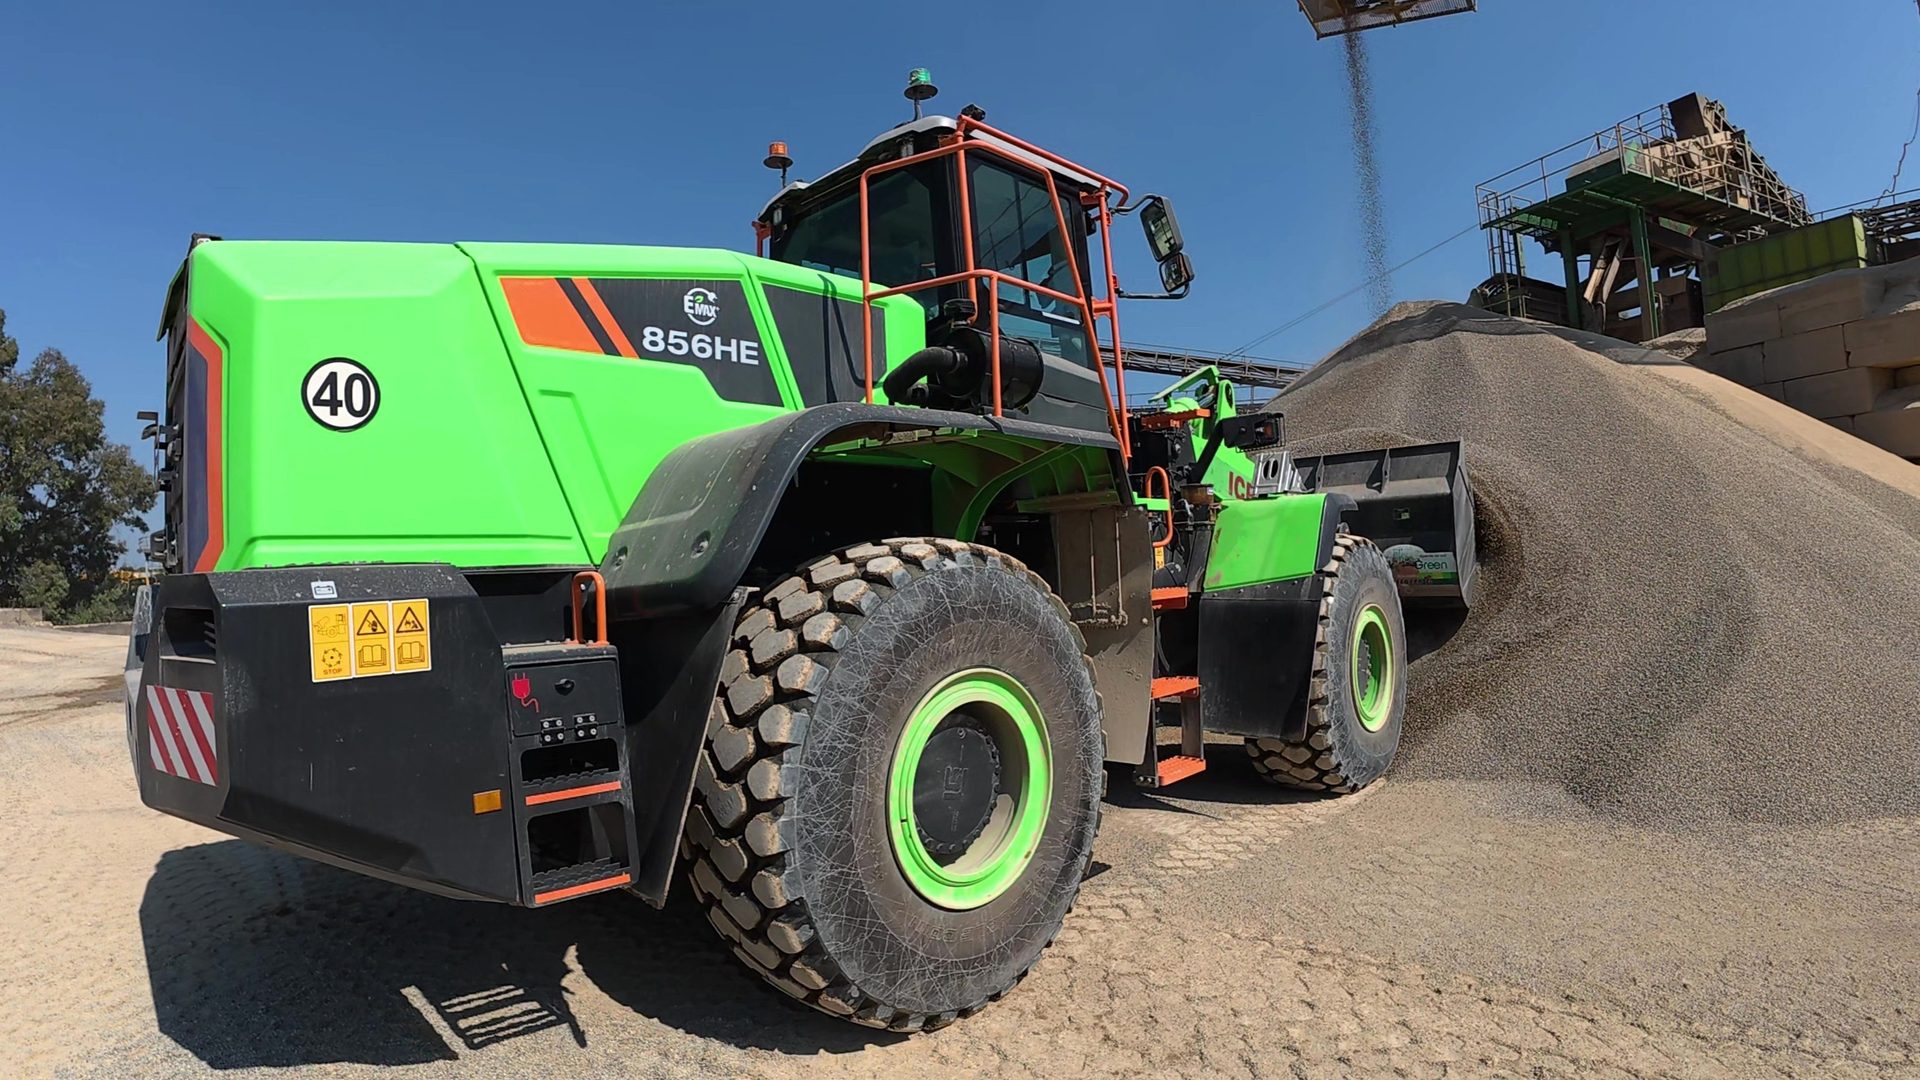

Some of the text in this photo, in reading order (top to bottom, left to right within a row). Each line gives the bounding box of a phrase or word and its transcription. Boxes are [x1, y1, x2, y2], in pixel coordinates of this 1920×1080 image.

[642, 326, 759, 365] 856HE
[312, 371, 371, 418] 40
[1416, 561, 1448, 570] Green
